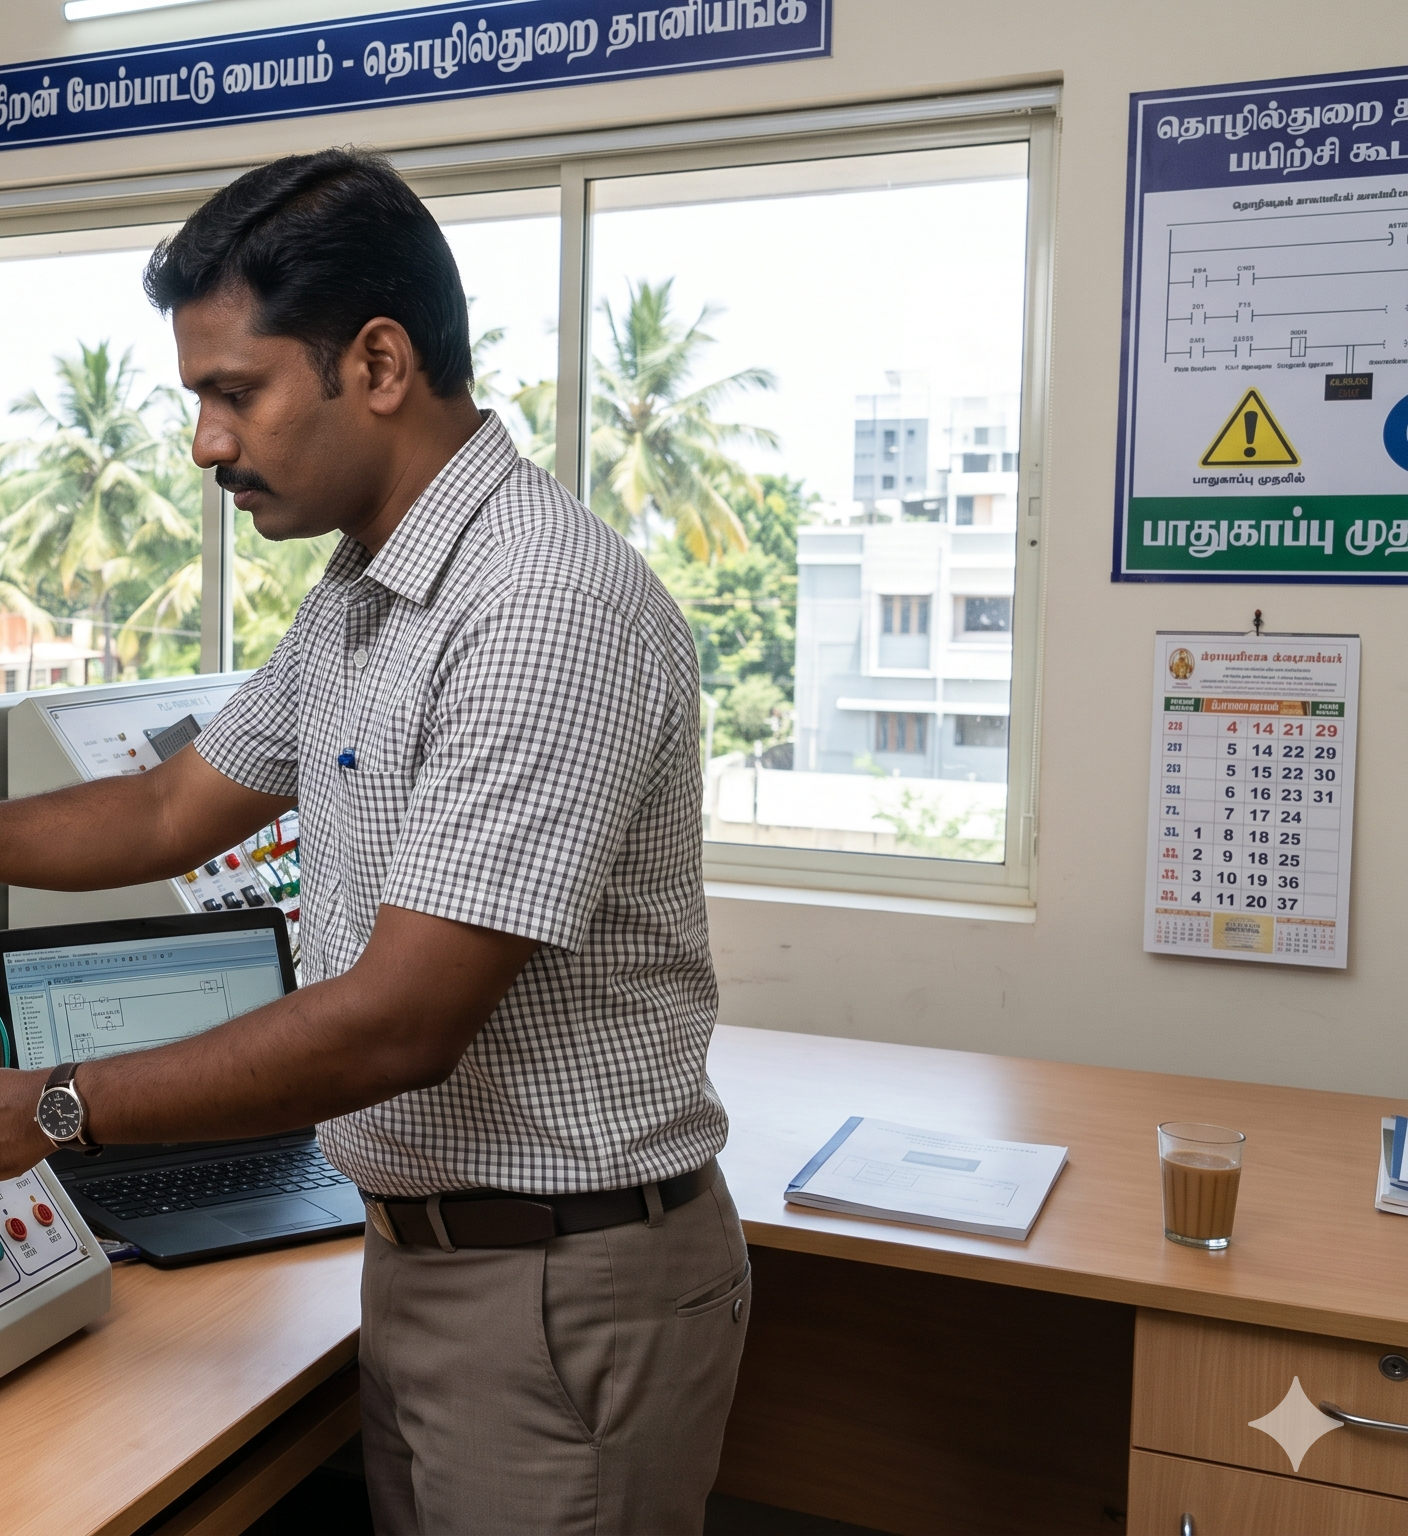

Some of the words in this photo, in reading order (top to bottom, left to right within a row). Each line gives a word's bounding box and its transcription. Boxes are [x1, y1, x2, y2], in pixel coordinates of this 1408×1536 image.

[66, 61, 216, 114] மேம்பாட்டு
[223, 39, 334, 94] மையம்
[363, 18, 599, 85] தொழில்துறை
[1157, 100, 1384, 145] தொழில்துறை
[1229, 136, 1340, 176] பயிற்சி
[1192, 473, 1253, 487] பாதுகாப்பு
[1257, 471, 1306, 486] முதலில்
[1142, 505, 1335, 558] பாதுகாப்பு
[1226, 721, 1238, 734] 4
[1252, 722, 1274, 736] 14
[1283, 723, 1304, 737] 21
[1315, 724, 1338, 738] 29
[1226, 742, 1237, 756] 5
[1252, 744, 1273, 758] 14
[1282, 745, 1305, 759] 22
[1314, 746, 1337, 760] 29
[1226, 764, 1236, 777] 5
[1251, 765, 1272, 779] 15
[1313, 768, 1336, 782] 30
[1225, 786, 1236, 799] 6
[1250, 787, 1271, 801] 16
[1281, 788, 1303, 802] 23
[1313, 790, 1333, 804] 31
[1224, 807, 1235, 820] 7
[1249, 808, 1271, 822] 17
[1280, 810, 1302, 824] 24
[1194, 826, 1202, 840] 1
[1223, 828, 1234, 842] 8
[1248, 830, 1270, 844] 18
[1279, 832, 1301, 846] 25
[1192, 848, 1203, 861] 2
[1222, 850, 1233, 863] 9
[1248, 851, 1269, 866] 18
[1278, 853, 1300, 868] 25
[1192, 869, 1202, 882] 3
[1216, 871, 1237, 885] 10
[1247, 873, 1268, 887] 19
[1277, 875, 1300, 890] 36
[1191, 891, 1202, 904] 4
[1216, 892, 1234, 906] 11
[1245, 895, 1267, 909] 20
[1277, 897, 1299, 911] 37
